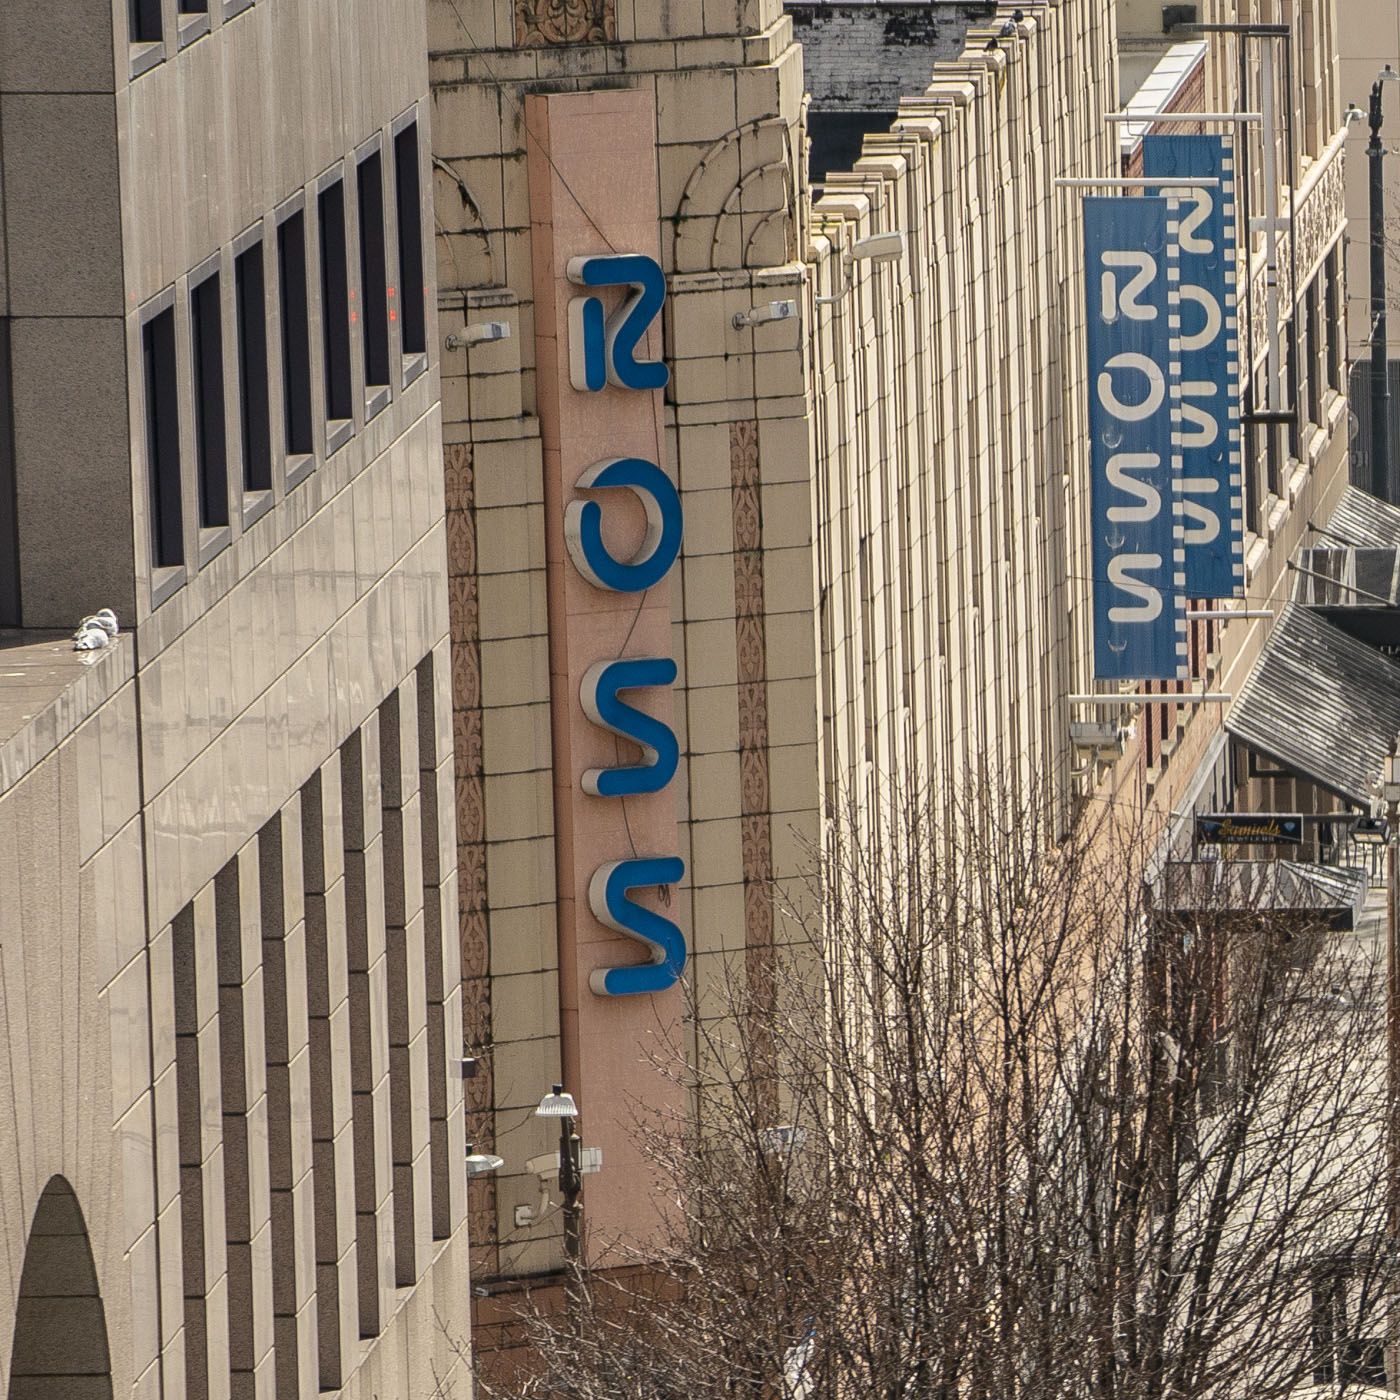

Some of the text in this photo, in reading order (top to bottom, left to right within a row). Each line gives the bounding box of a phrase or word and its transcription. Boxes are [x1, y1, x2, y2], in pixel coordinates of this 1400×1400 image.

[564, 252, 689, 998] ROSS
[1098, 250, 1167, 625] ROSS
[1218, 818, 1281, 837] Samuels
